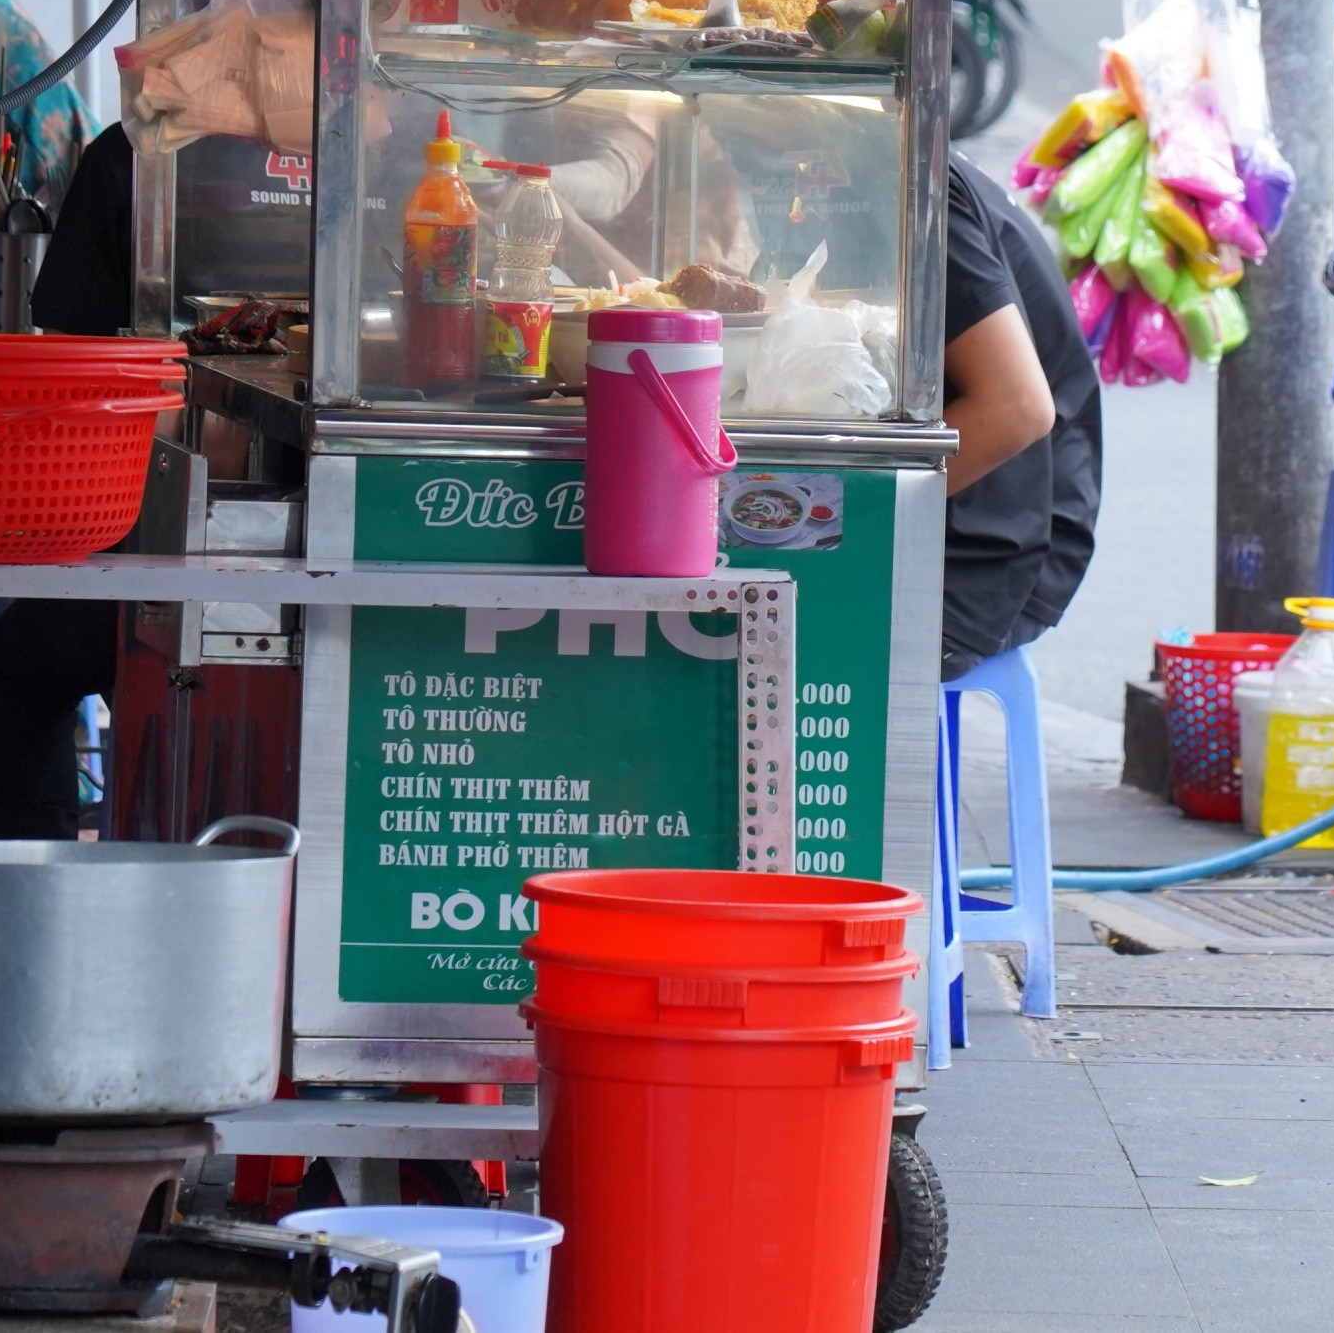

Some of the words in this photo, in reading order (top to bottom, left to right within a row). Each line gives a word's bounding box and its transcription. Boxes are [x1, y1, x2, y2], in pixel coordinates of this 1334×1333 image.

[251, 190, 300, 206] SOUND
[415, 478, 538, 529] Đức
[384, 670, 416, 696] TÔ
[425, 672, 474, 701] ĐẶC
[483, 673, 542, 702] BIỆT
[383, 704, 415, 730] TÔ
[423, 706, 527, 733] THƯỜNG
[382, 738, 414, 764] TÔ
[422, 738, 475, 765] NHỎ
[381, 772, 442, 799] CHÍN
[451, 777, 511, 803] THỊT
[518, 774, 590, 801] THÊM
[380, 806, 441, 832] CHÍN
[449, 811, 510, 837] THỊT
[518, 808, 589, 835] THÊM
[598, 810, 649, 839] HỘT
[657, 811, 690, 836] GÀ
[378, 840, 448, 866] BÁNH
[457, 840, 510, 868] PHỞ
[517, 842, 589, 869] THÊM
[411, 888, 485, 931] BÒ
[427, 952, 472, 970] Mở
[476, 953, 522, 970] cửa
[483, 973, 529, 991] Các
